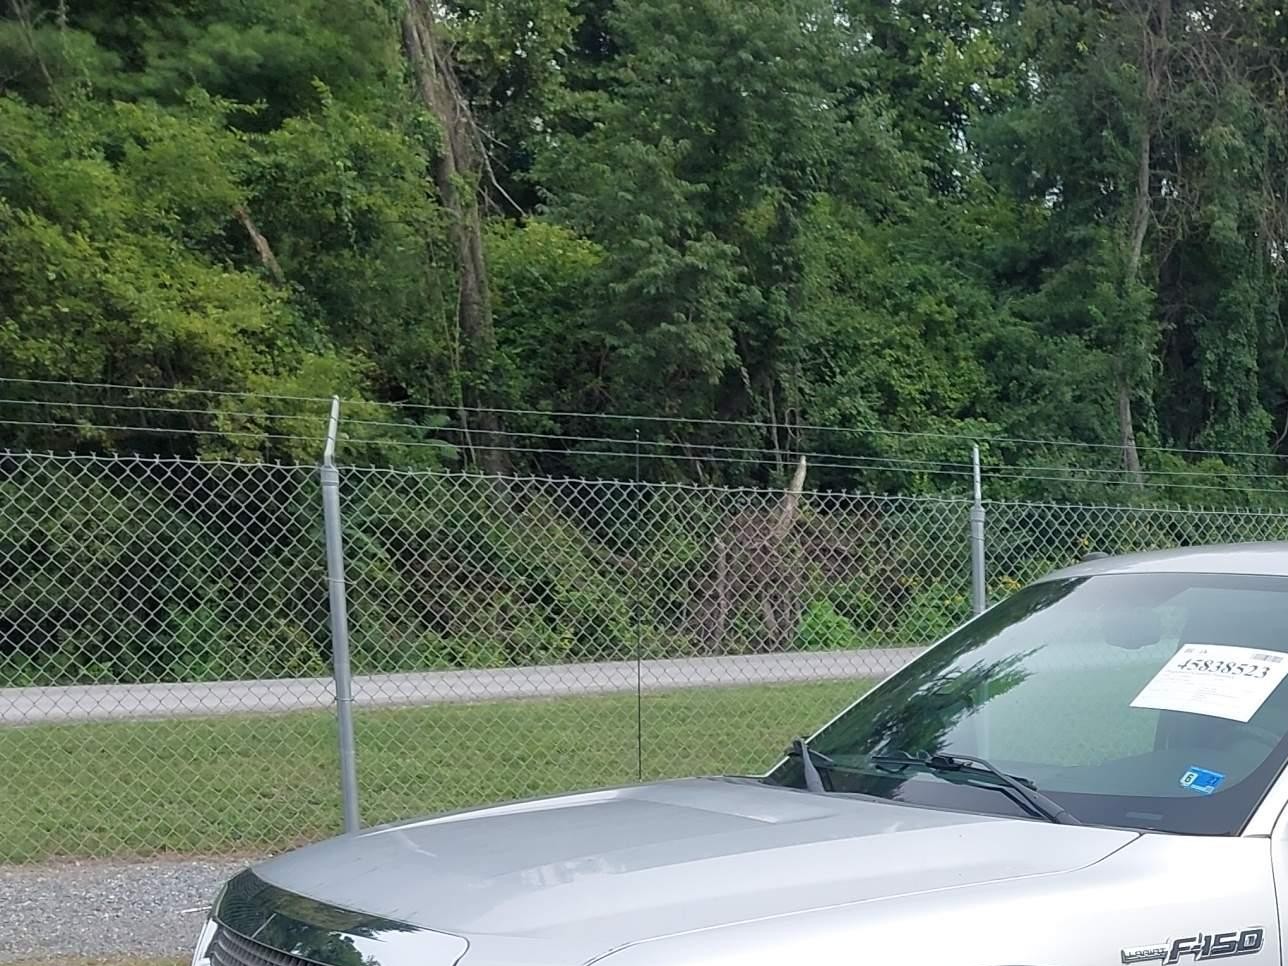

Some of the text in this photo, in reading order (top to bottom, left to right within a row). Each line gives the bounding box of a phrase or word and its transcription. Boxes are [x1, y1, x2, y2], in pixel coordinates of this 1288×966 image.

[1177, 658, 1271, 679] 45838523
[1184, 773, 1195, 783] 6
[1167, 928, 1264, 963] F-150
